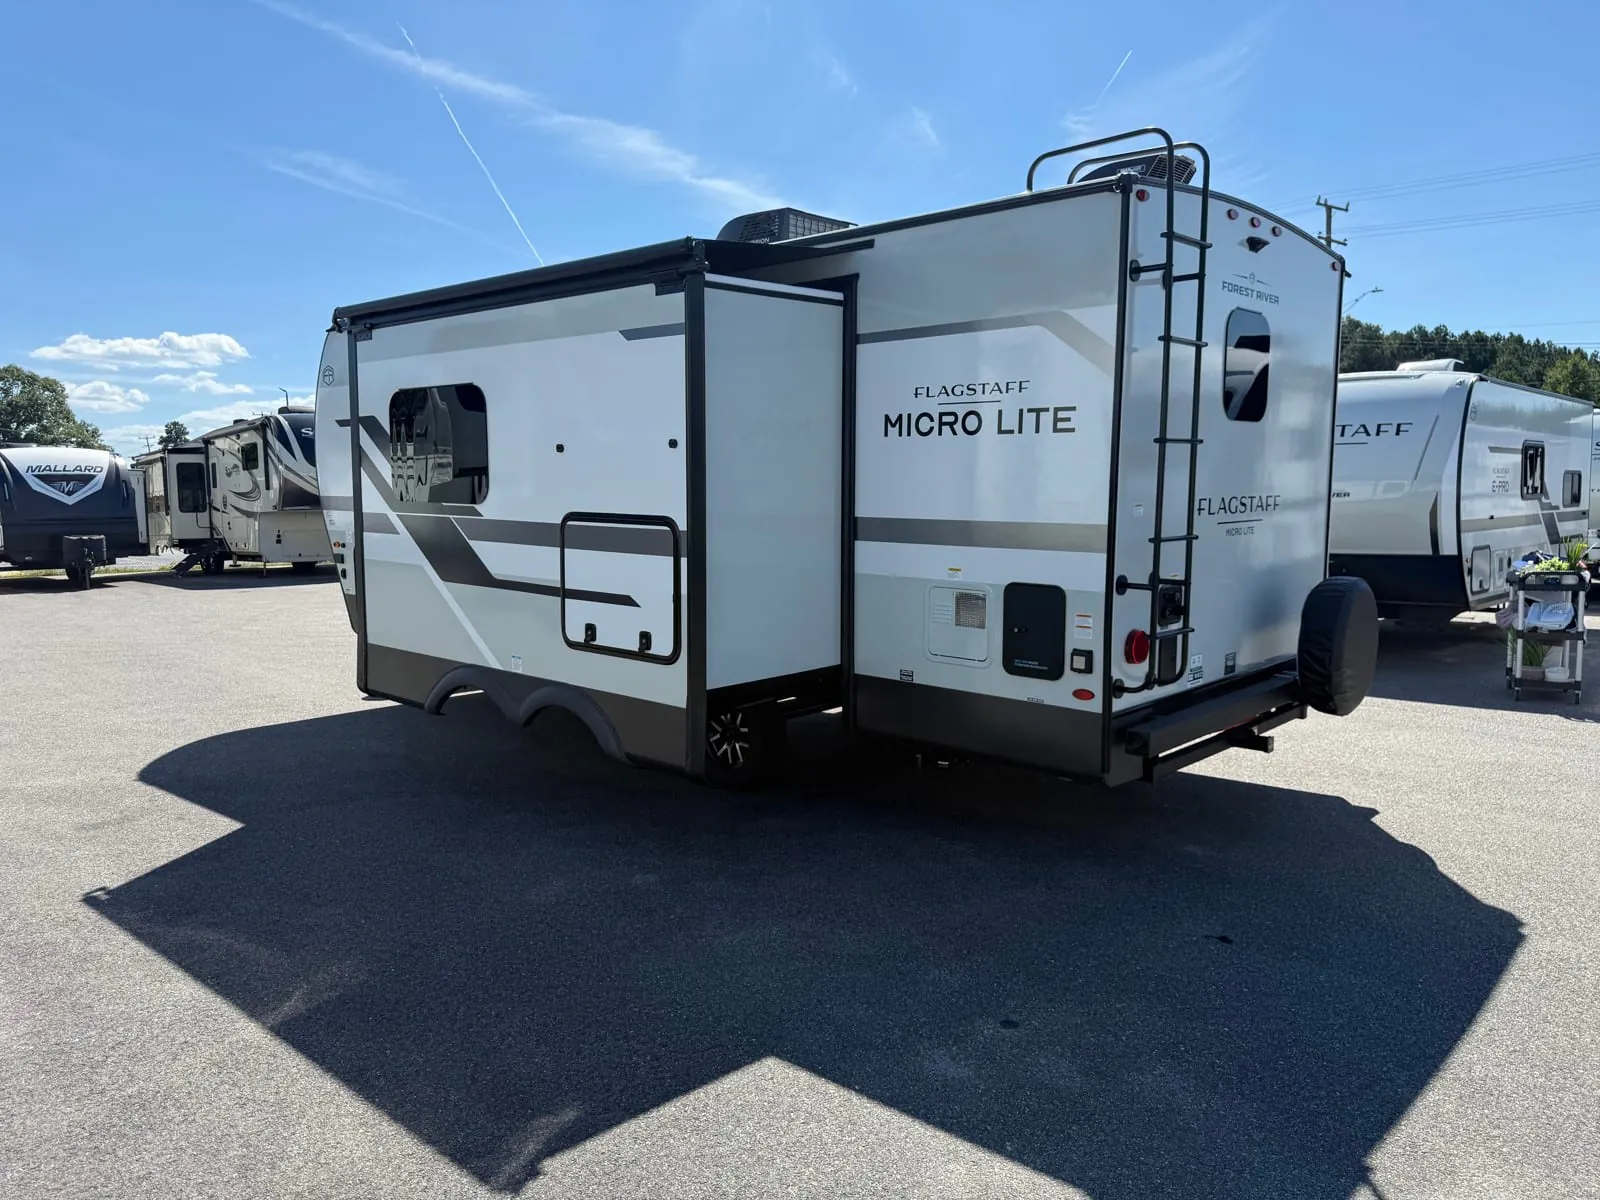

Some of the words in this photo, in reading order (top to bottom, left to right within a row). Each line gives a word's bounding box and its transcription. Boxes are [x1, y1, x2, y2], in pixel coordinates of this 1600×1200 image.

[1221, 280, 1256, 299] FOREST
[1256, 290, 1280, 305] RIVER
[913, 380, 1031, 399] FLAGSTAFF
[883, 409, 983, 438] MICRO
[997, 405, 1077, 436] LITE
[25, 464, 104, 474] MALLARD
[1491, 480, 1510, 493] E-PRO
[1197, 495, 1281, 516] FLAGSTAFF
[1225, 527, 1243, 537] MICRO
[1243, 526, 1256, 536] LITE
